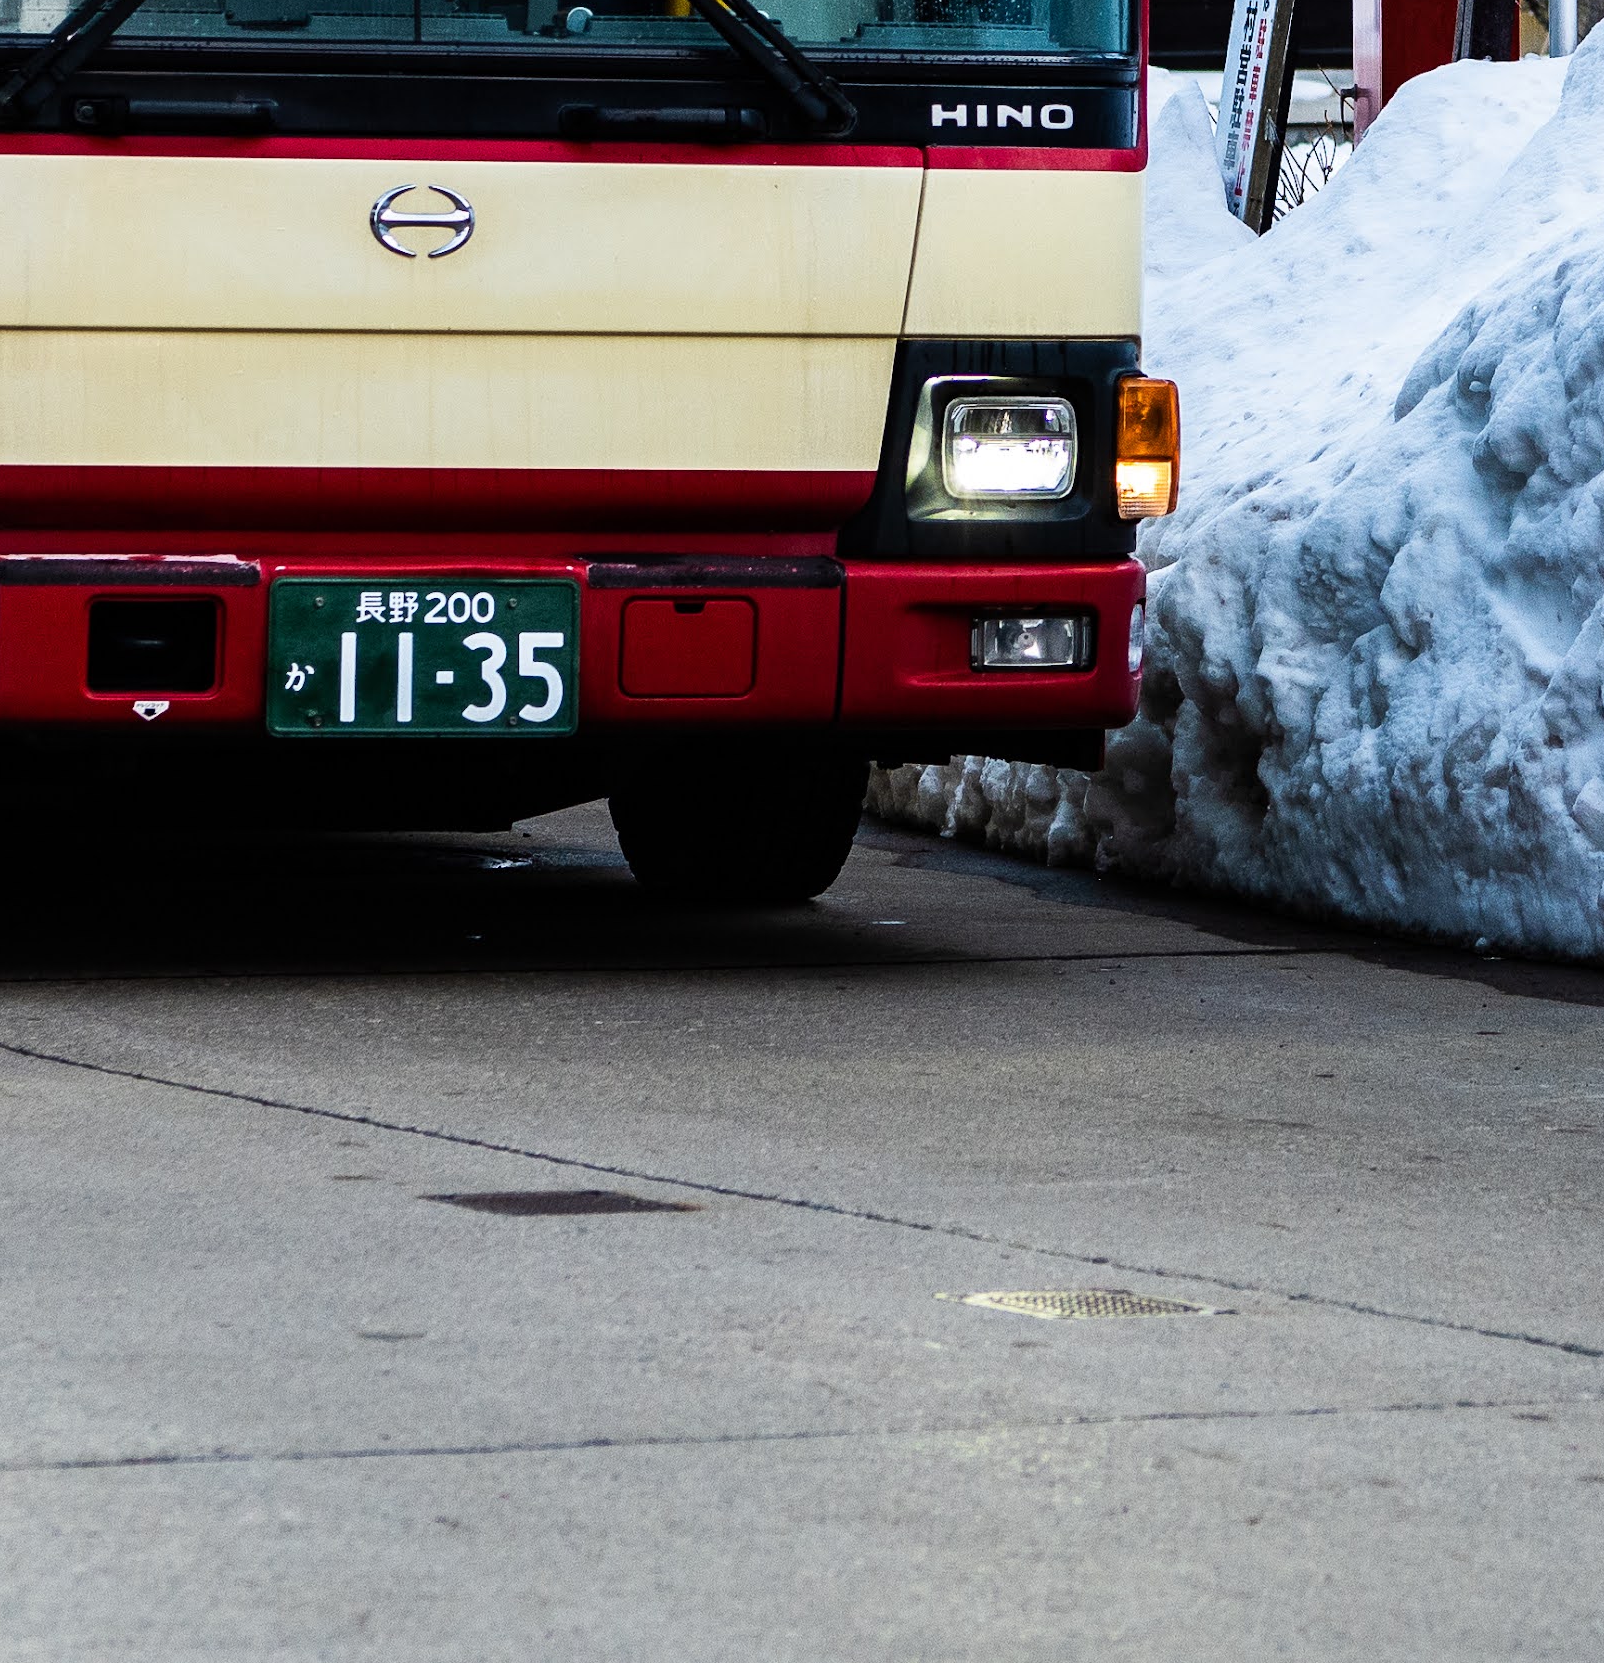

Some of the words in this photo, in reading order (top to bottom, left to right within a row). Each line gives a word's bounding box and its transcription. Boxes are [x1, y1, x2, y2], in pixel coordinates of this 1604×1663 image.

[931, 103, 1075, 130] HINO
[284, 662, 315, 693] か
[338, 630, 566, 724] 11-35
